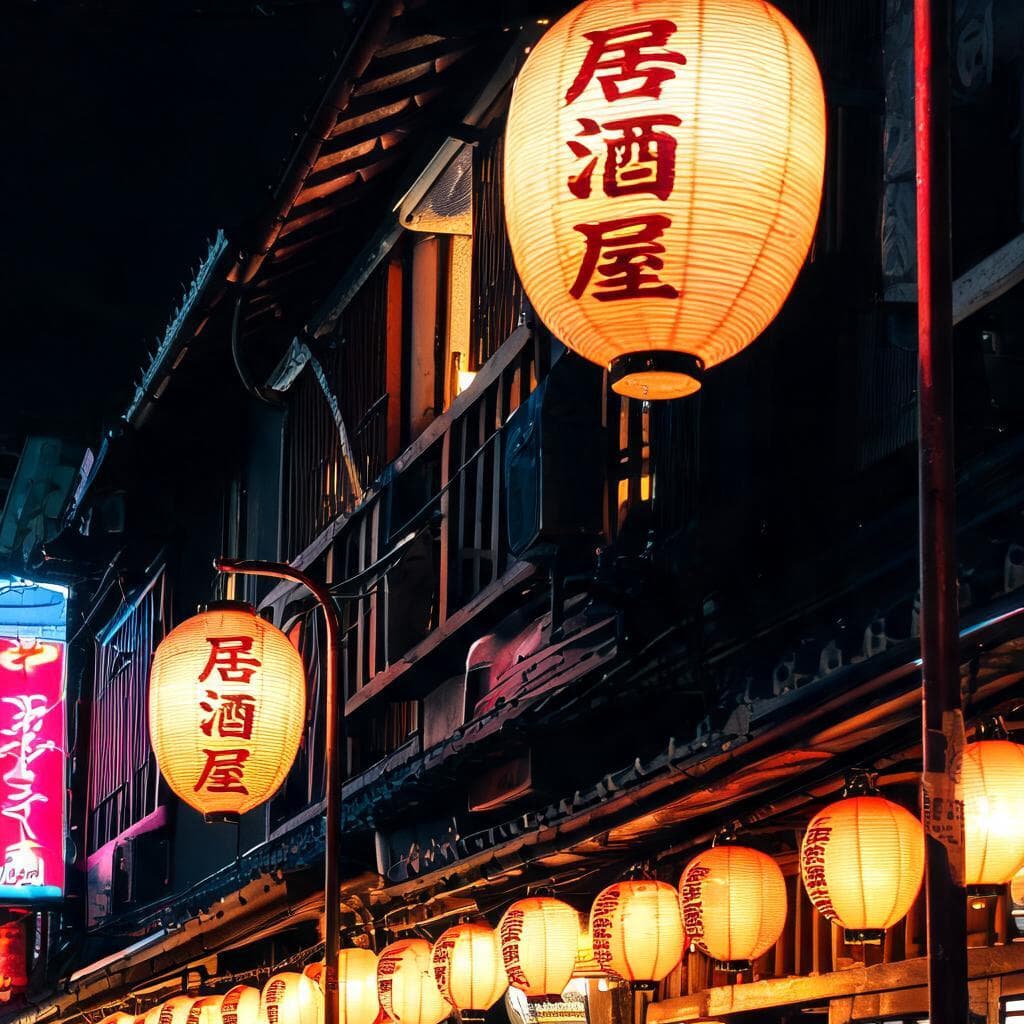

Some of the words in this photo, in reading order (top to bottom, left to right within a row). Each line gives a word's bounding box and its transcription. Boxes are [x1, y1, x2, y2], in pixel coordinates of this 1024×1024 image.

[564, 20, 687, 303] 居酒屋
[193, 635, 262, 796] 居酒屋
